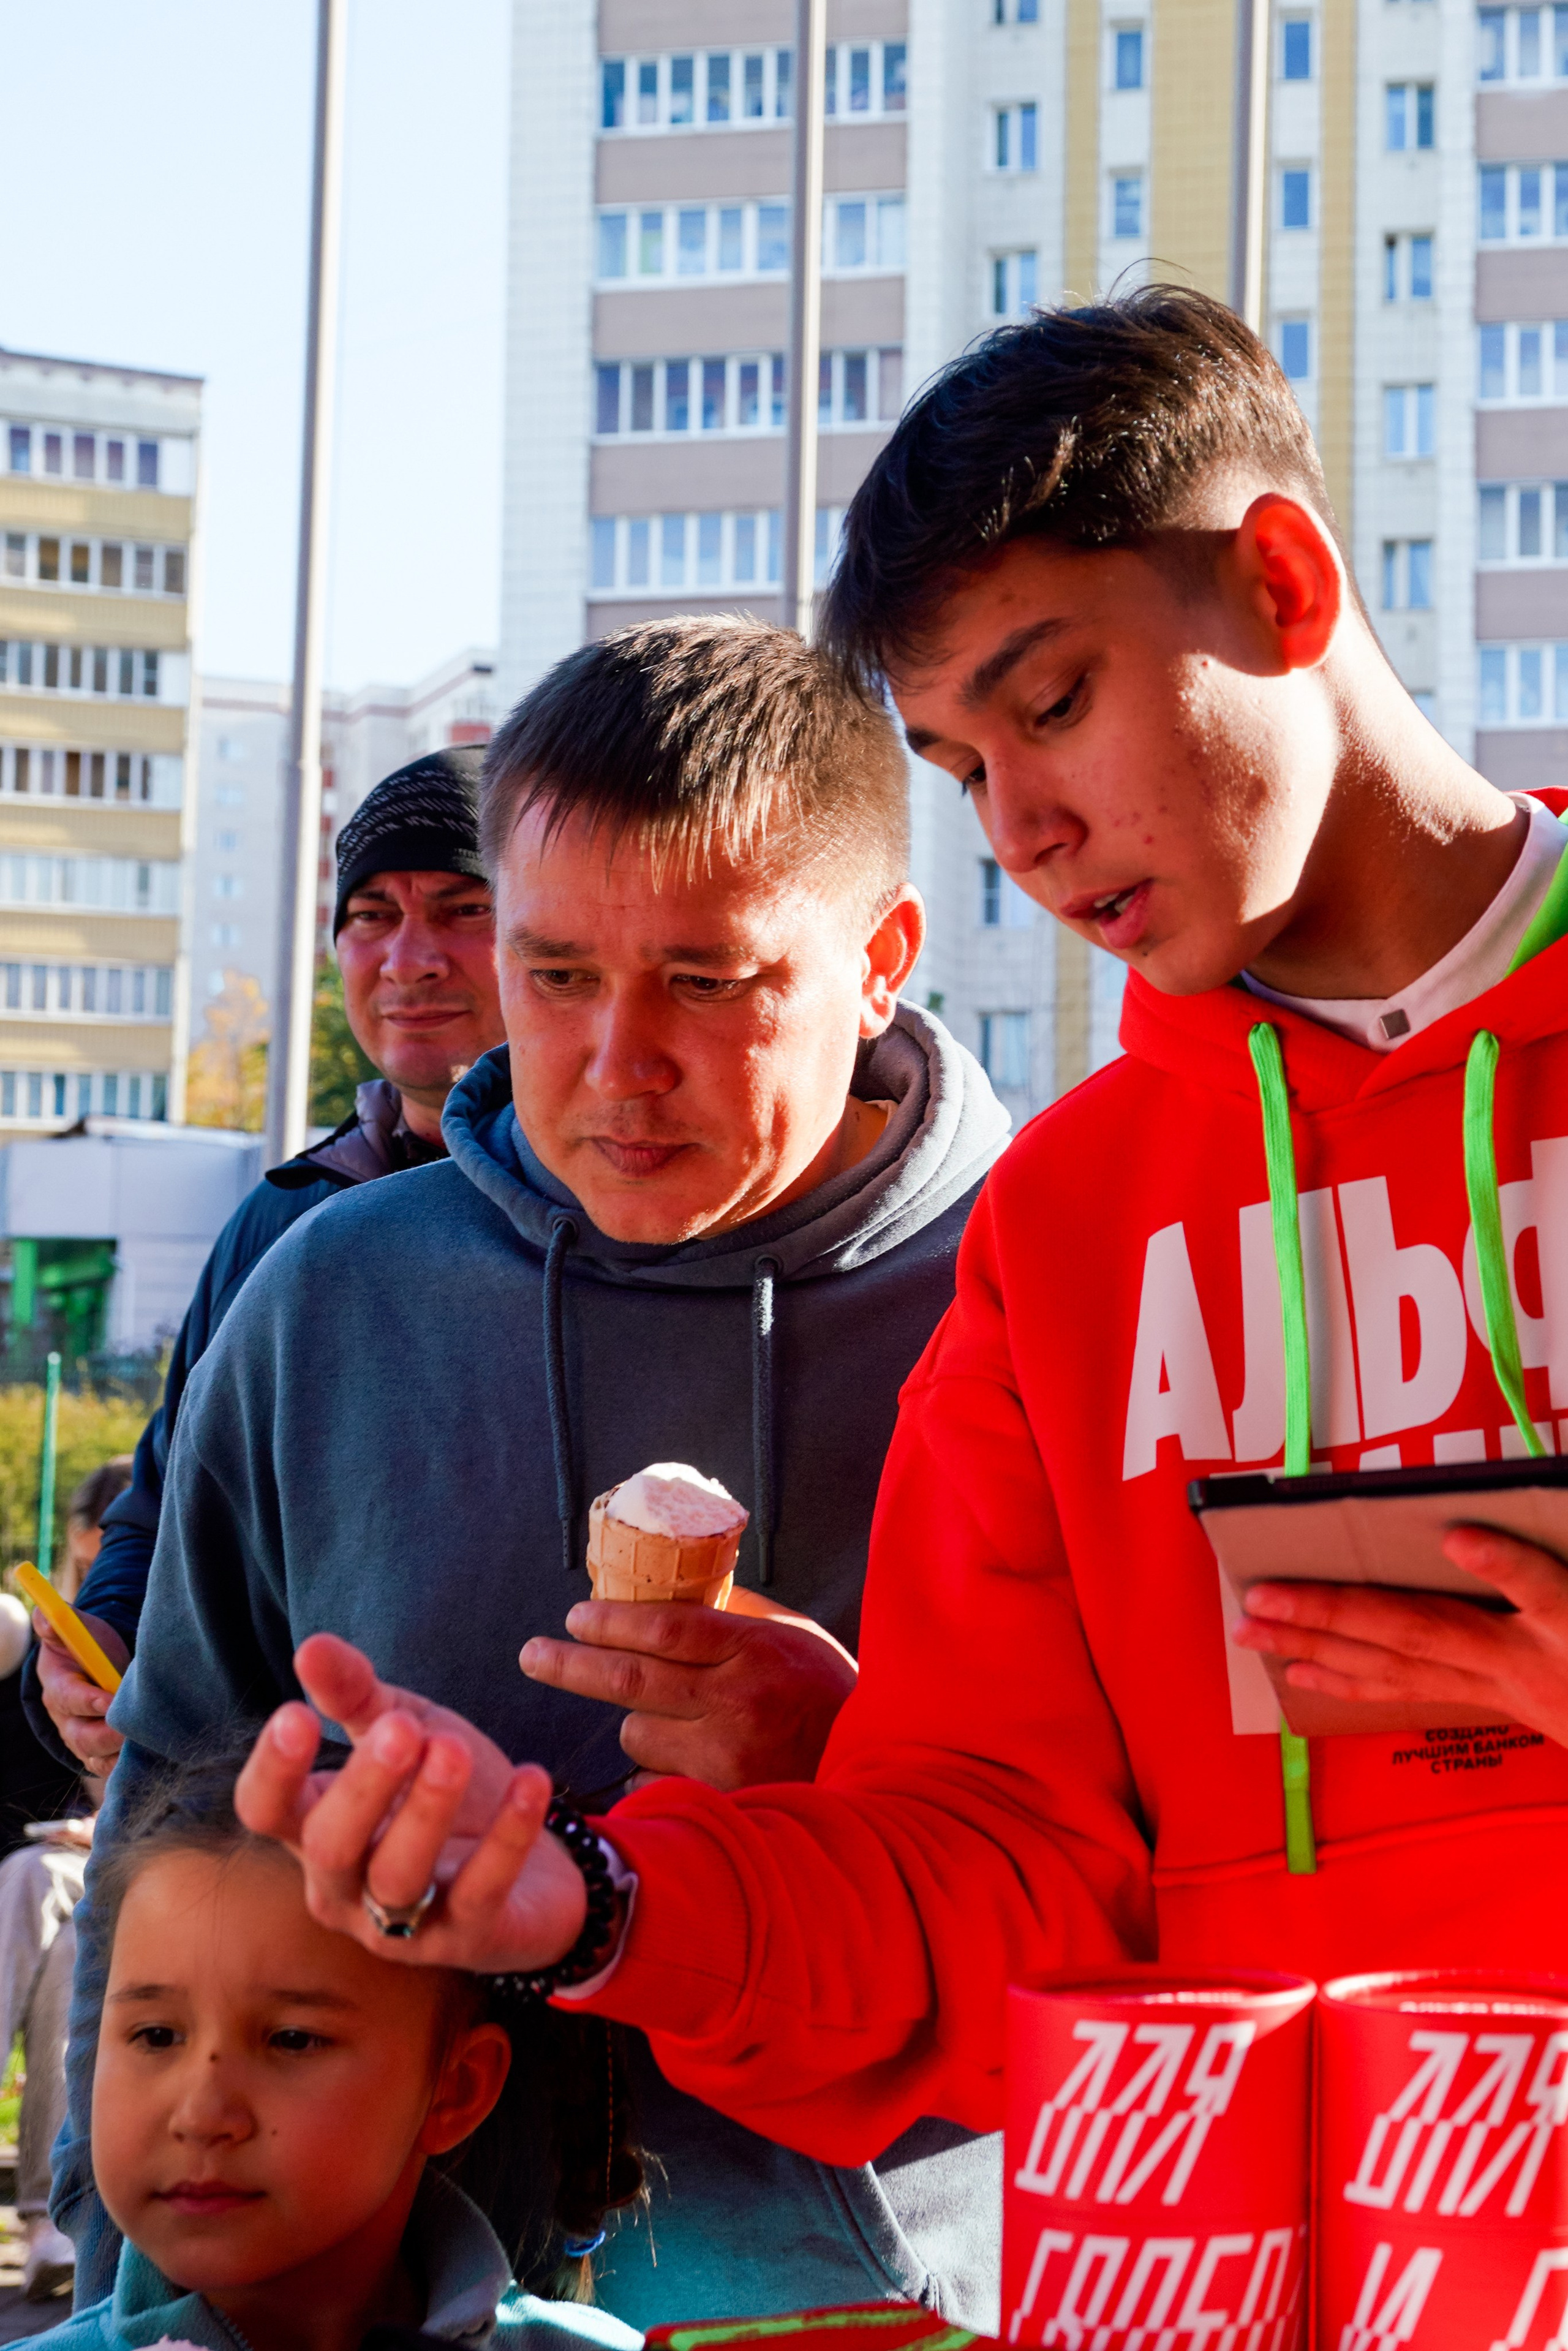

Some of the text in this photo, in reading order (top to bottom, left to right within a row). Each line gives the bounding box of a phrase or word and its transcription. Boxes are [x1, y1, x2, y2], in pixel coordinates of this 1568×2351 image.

[1425, 1726, 1509, 1742] СОЗДАНО
[1392, 1734, 1544, 1764] ЛУЧШИМ БАНКОМ
[1431, 1754, 1502, 1773] СТРАНЫ
